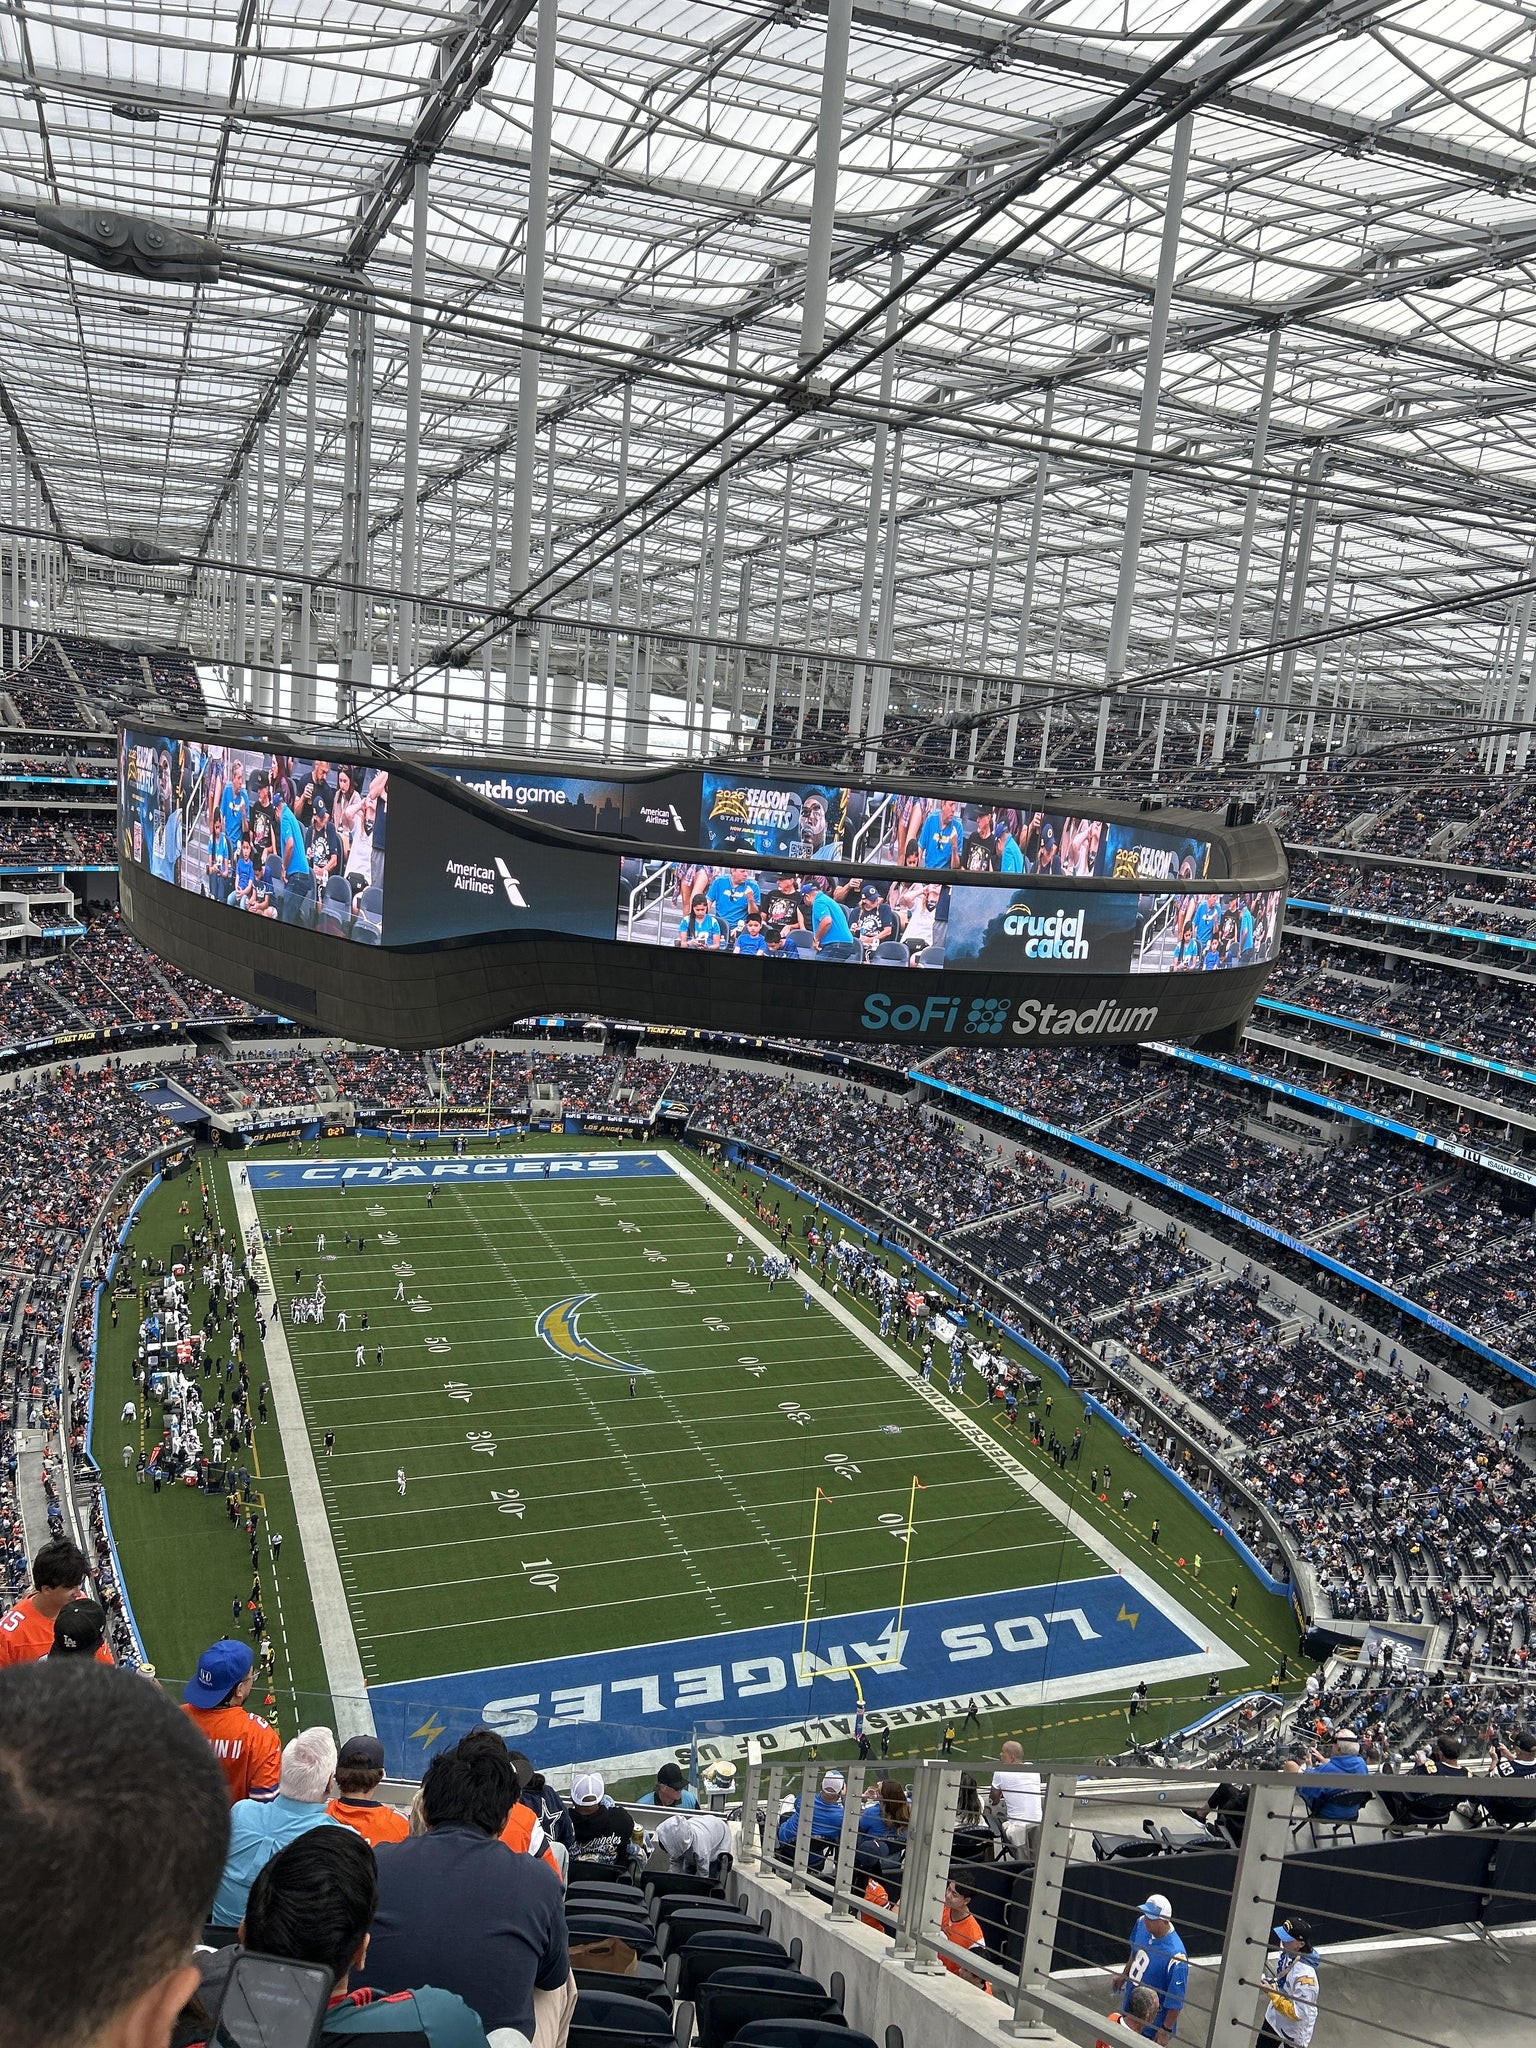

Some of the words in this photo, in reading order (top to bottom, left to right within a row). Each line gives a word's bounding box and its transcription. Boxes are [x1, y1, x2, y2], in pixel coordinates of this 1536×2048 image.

[516, 786, 566, 805] game
[716, 789, 745, 801] 2026
[745, 788, 791, 811] SEASON
[640, 806, 670, 818] American
[645, 815, 669, 826] Airlines
[747, 806, 792, 830] TICKETS
[1116, 848, 1139, 864] 2026
[1136, 846, 1174, 880] SEASON
[446, 859, 495, 881] American
[454, 876, 494, 895] Airlines
[1004, 909, 1085, 939] crucial
[1025, 934, 1089, 960] catch
[860, 993, 961, 1033] SoFi
[1012, 999, 1159, 1035] Stadium
[54, 1034, 78, 1045] TICKET
[77, 1032, 96, 1042] PACK
[647, 1026, 670, 1036] TICKET
[670, 1028, 688, 1036] PACK
[265, 1129, 302, 1141] ANGELES
[327, 1127, 345, 1137] 0:27
[600, 1125, 634, 1134] ANGELES
[302, 1160, 619, 1184] CHARGERS
[1509, 1167, 1533, 1182] LIKELY
[702, 1317, 731, 1332] 50
[424, 1336, 451, 1353] 50
[738, 1357, 768, 1373] 40
[444, 1381, 472, 1400] 40
[906, 1374, 957, 1413] CANCER
[778, 1402, 812, 1423] 30
[466, 1430, 497, 1452] 30
[951, 1416, 1028, 1477] INTERCEPT
[824, 1453, 861, 1477] 20
[491, 1488, 526, 1515] 20
[878, 1513, 918, 1539] 10
[521, 1558, 559, 1587] 10
[63, 1634, 77, 1648] LA
[941, 1608, 1103, 1662] LOS
[482, 1616, 910, 1738] ANGELES
[980, 1691, 1012, 1708] IT
[865, 1699, 967, 1729] TAKES
[790, 1717, 851, 1742] ALL
[209, 1739, 229, 1759] IN
[674, 1744, 721, 1766] US
[736, 1733, 779, 1755] OF
